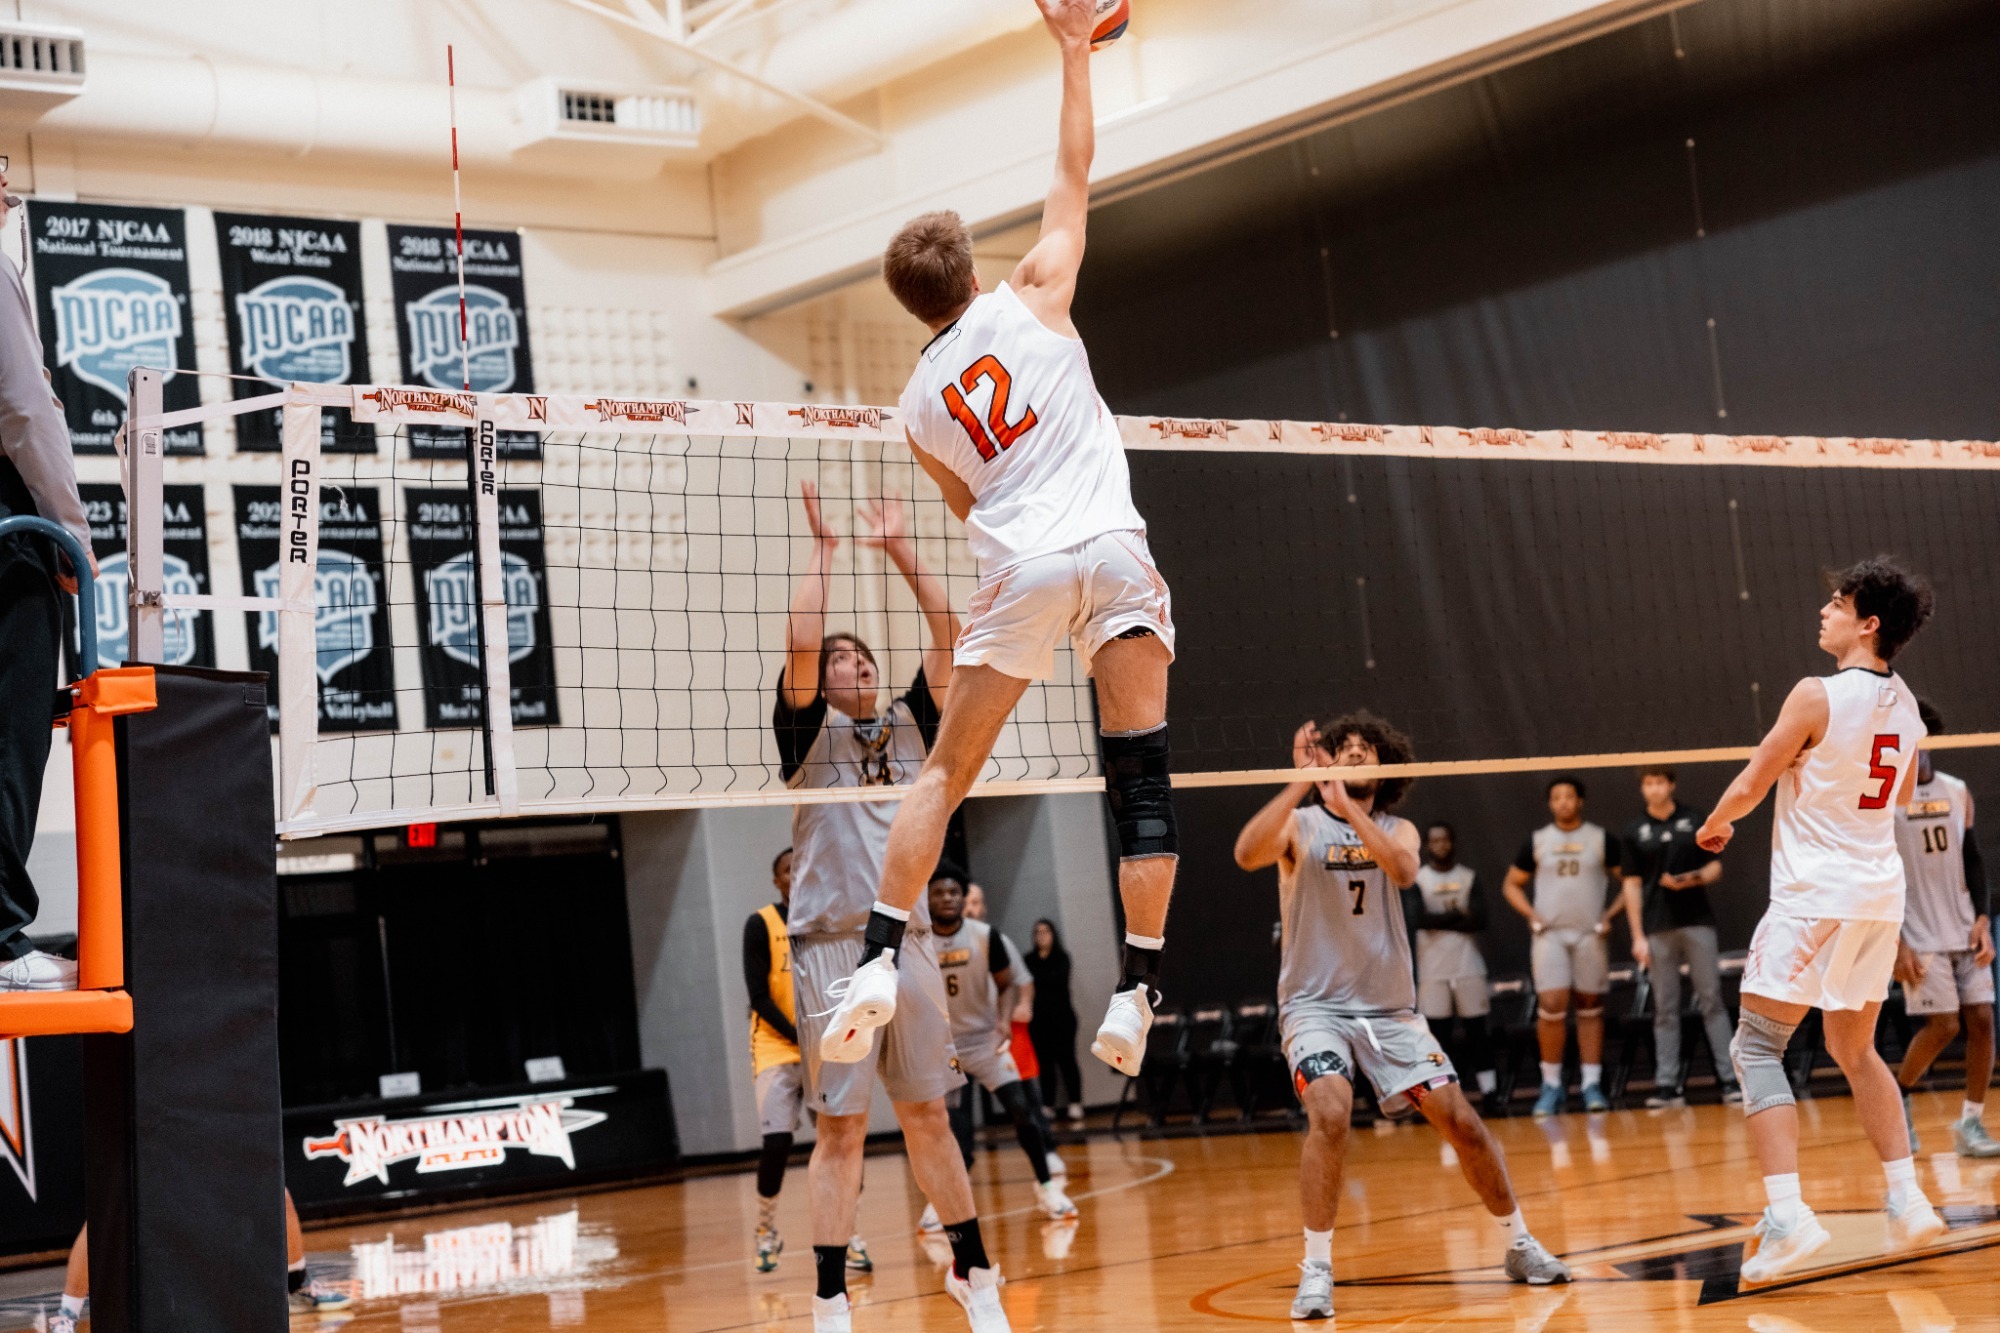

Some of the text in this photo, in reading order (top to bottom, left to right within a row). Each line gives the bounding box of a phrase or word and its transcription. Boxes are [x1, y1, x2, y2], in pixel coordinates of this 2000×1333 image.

[46, 215, 171, 245] 2017 NJCAA
[278, 229, 347, 253] NJCAA
[56, 293, 176, 356] NJCAA
[243, 300, 349, 362] NJCAA
[378, 387, 475, 420] NORTHAMPTON
[527, 396, 548, 424] N
[598, 399, 686, 426] NORTHAMPTON
[734, 402, 755, 429] N
[941, 354, 1038, 463] 12
[801, 406, 882, 432] NORTHAMPTON
[247, 501, 280, 522] 202
[1858, 733, 1901, 810] 5
[1921, 825, 1948, 854] 10
[1556, 859, 1580, 877] 20
[1348, 880, 1366, 915] 7
[946, 973, 960, 997] 6
[335, 1101, 576, 1186] NORTHAMPTON
